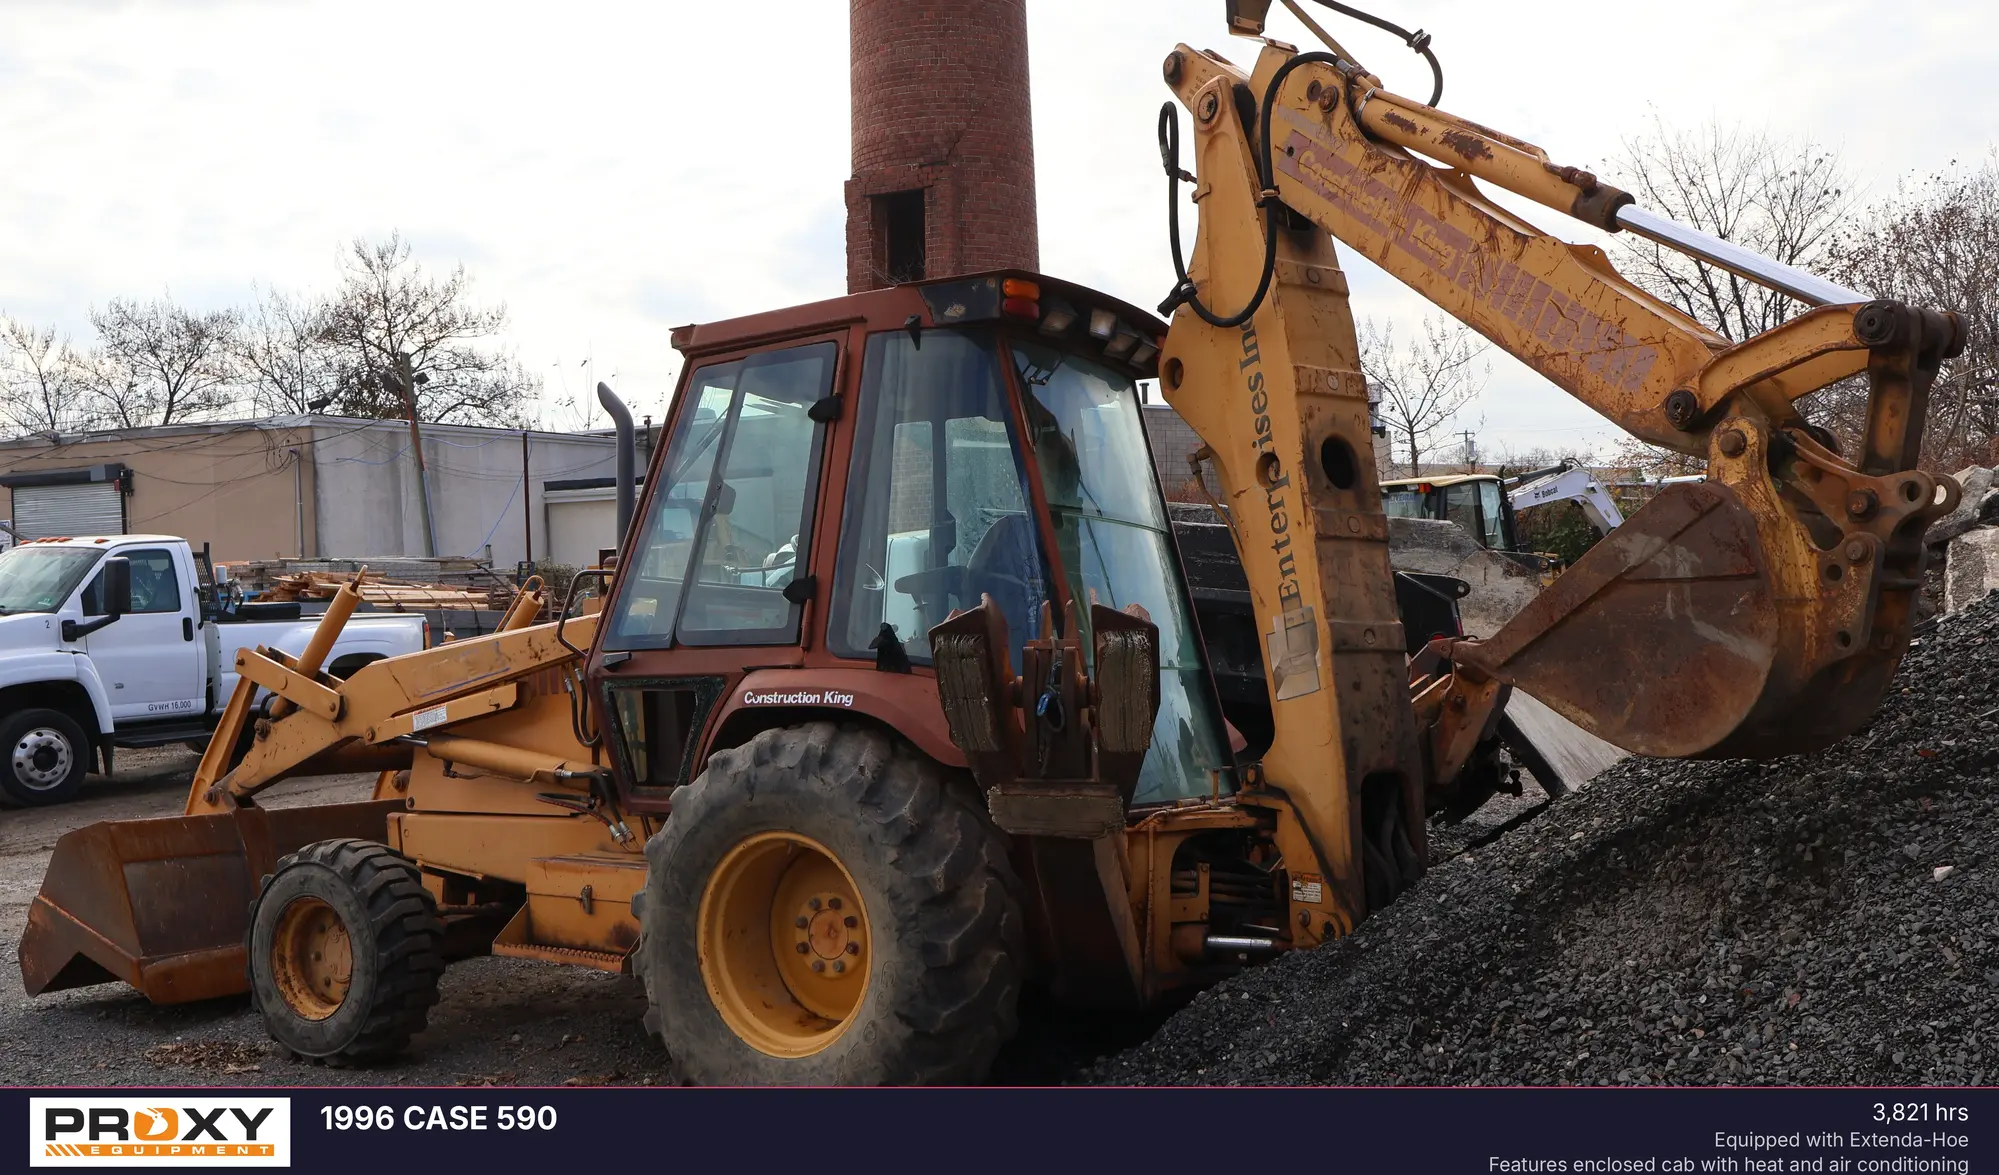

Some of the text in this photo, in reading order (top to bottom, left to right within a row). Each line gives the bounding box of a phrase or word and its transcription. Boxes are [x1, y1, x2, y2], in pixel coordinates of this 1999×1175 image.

[1409, 219, 1456, 271] King
[1248, 371, 1300, 601] Enterises
[1541, 486, 1559, 498] Bobcat
[171, 700, 192, 710] 16,000
[744, 691, 854, 706] Construction King
